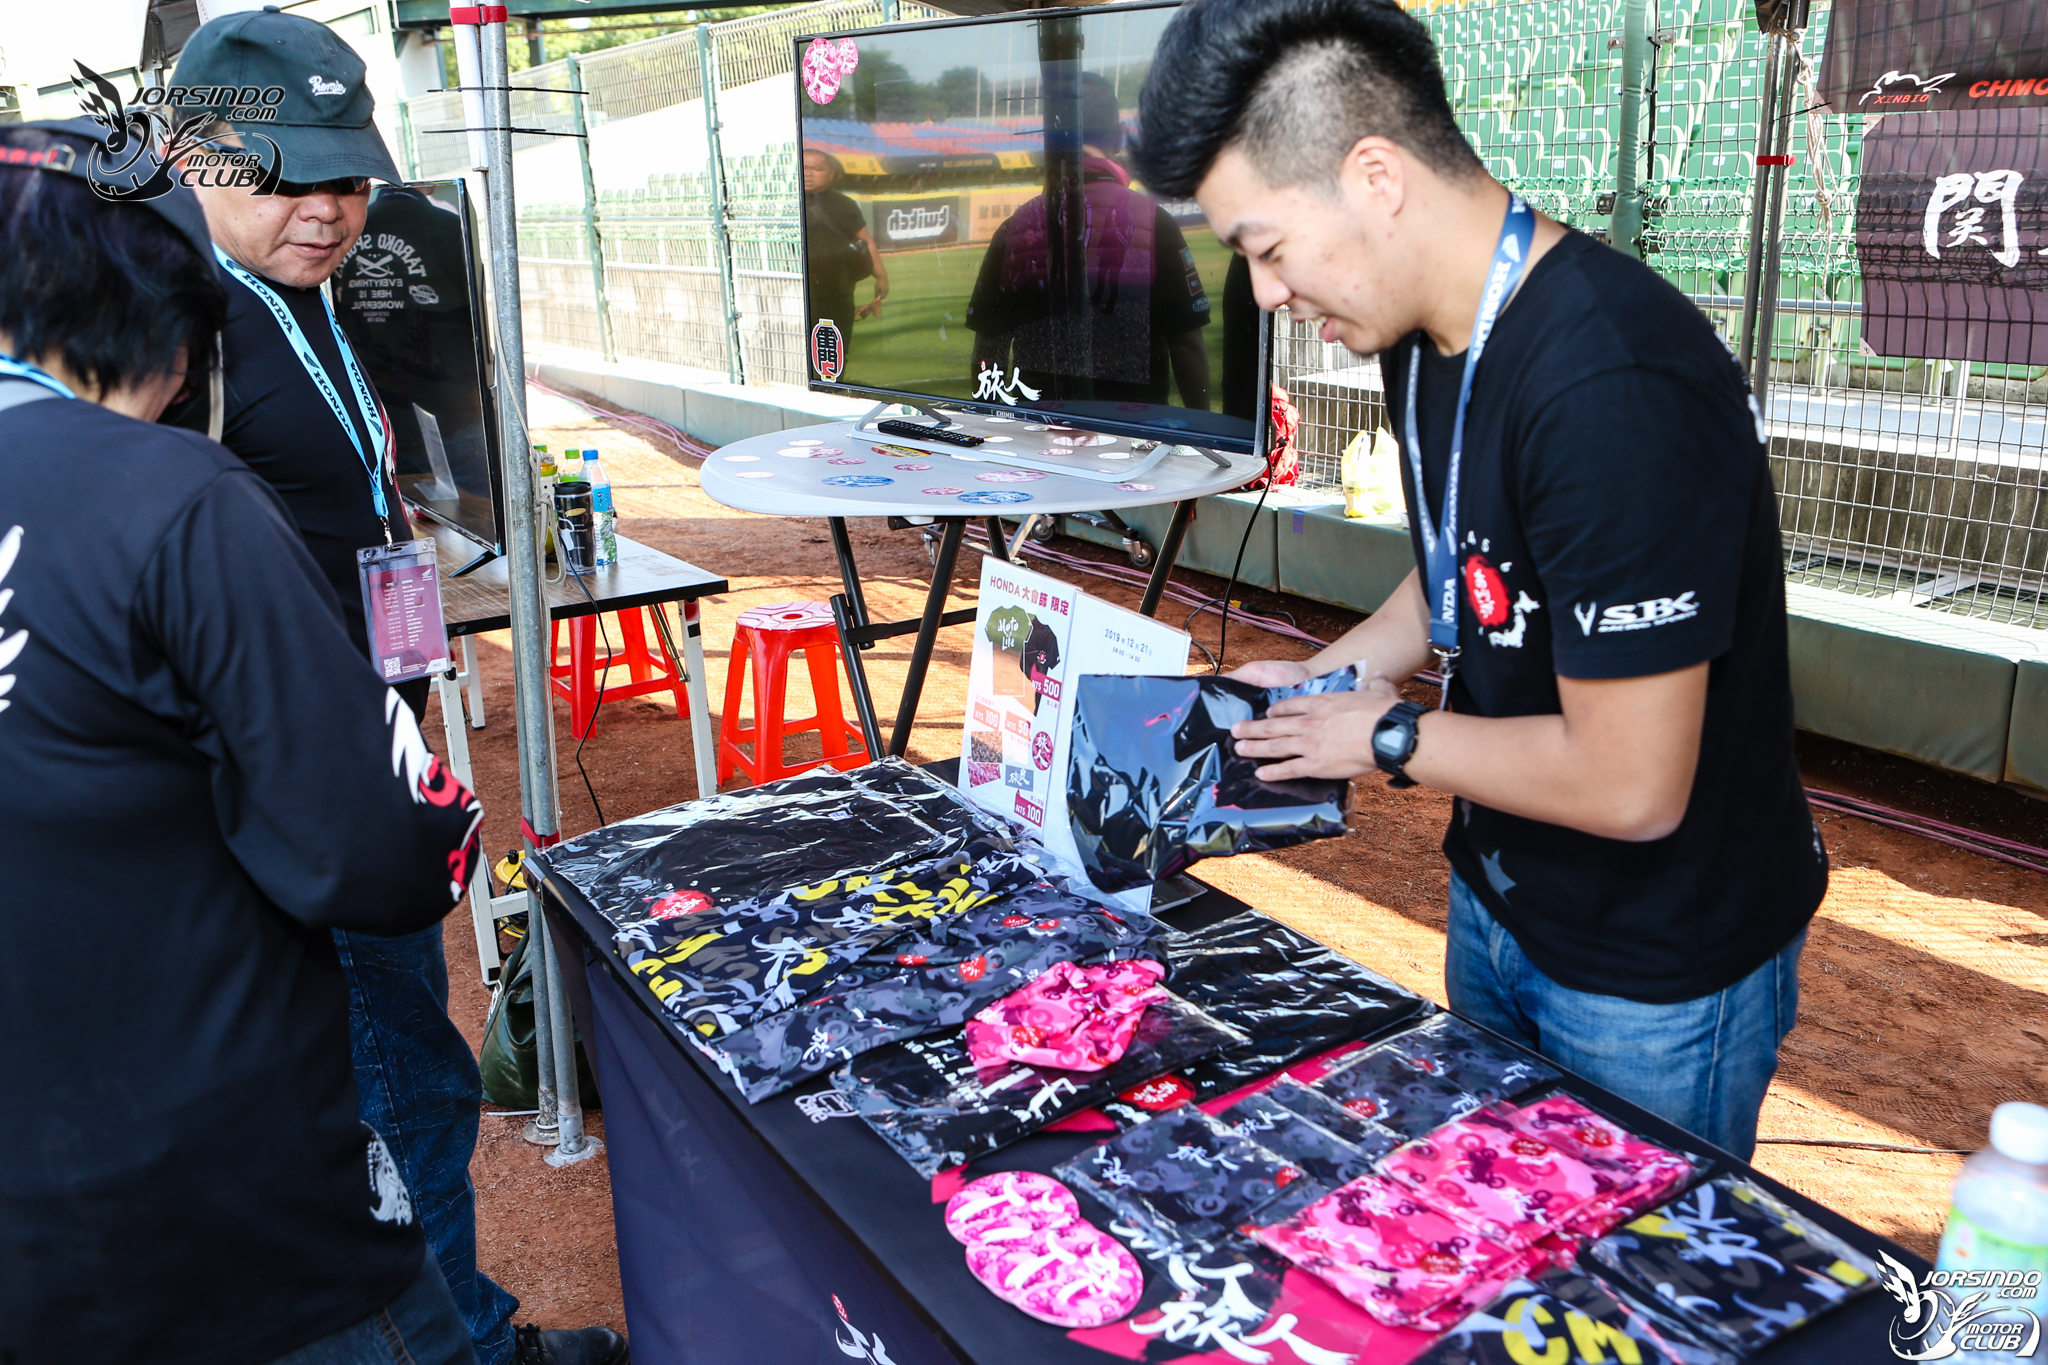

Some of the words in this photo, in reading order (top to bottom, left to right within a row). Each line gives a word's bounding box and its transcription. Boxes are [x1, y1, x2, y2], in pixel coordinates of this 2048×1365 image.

[1873, 94, 1930, 105] XINBIO
[242, 273, 293, 335] HONDA
[314, 370, 352, 435] HONDA
[350, 361, 377, 418] HONDA
[972, 362, 1042, 406] 旅人
[1442, 578, 1456, 623] NDA
[1043, 678, 1060, 698] 500
[985, 710, 998, 727] 100
[1018, 719, 1029, 737] 50
[1027, 804, 1041, 823] 100
[1129, 1297, 1360, 1365] 旅人
